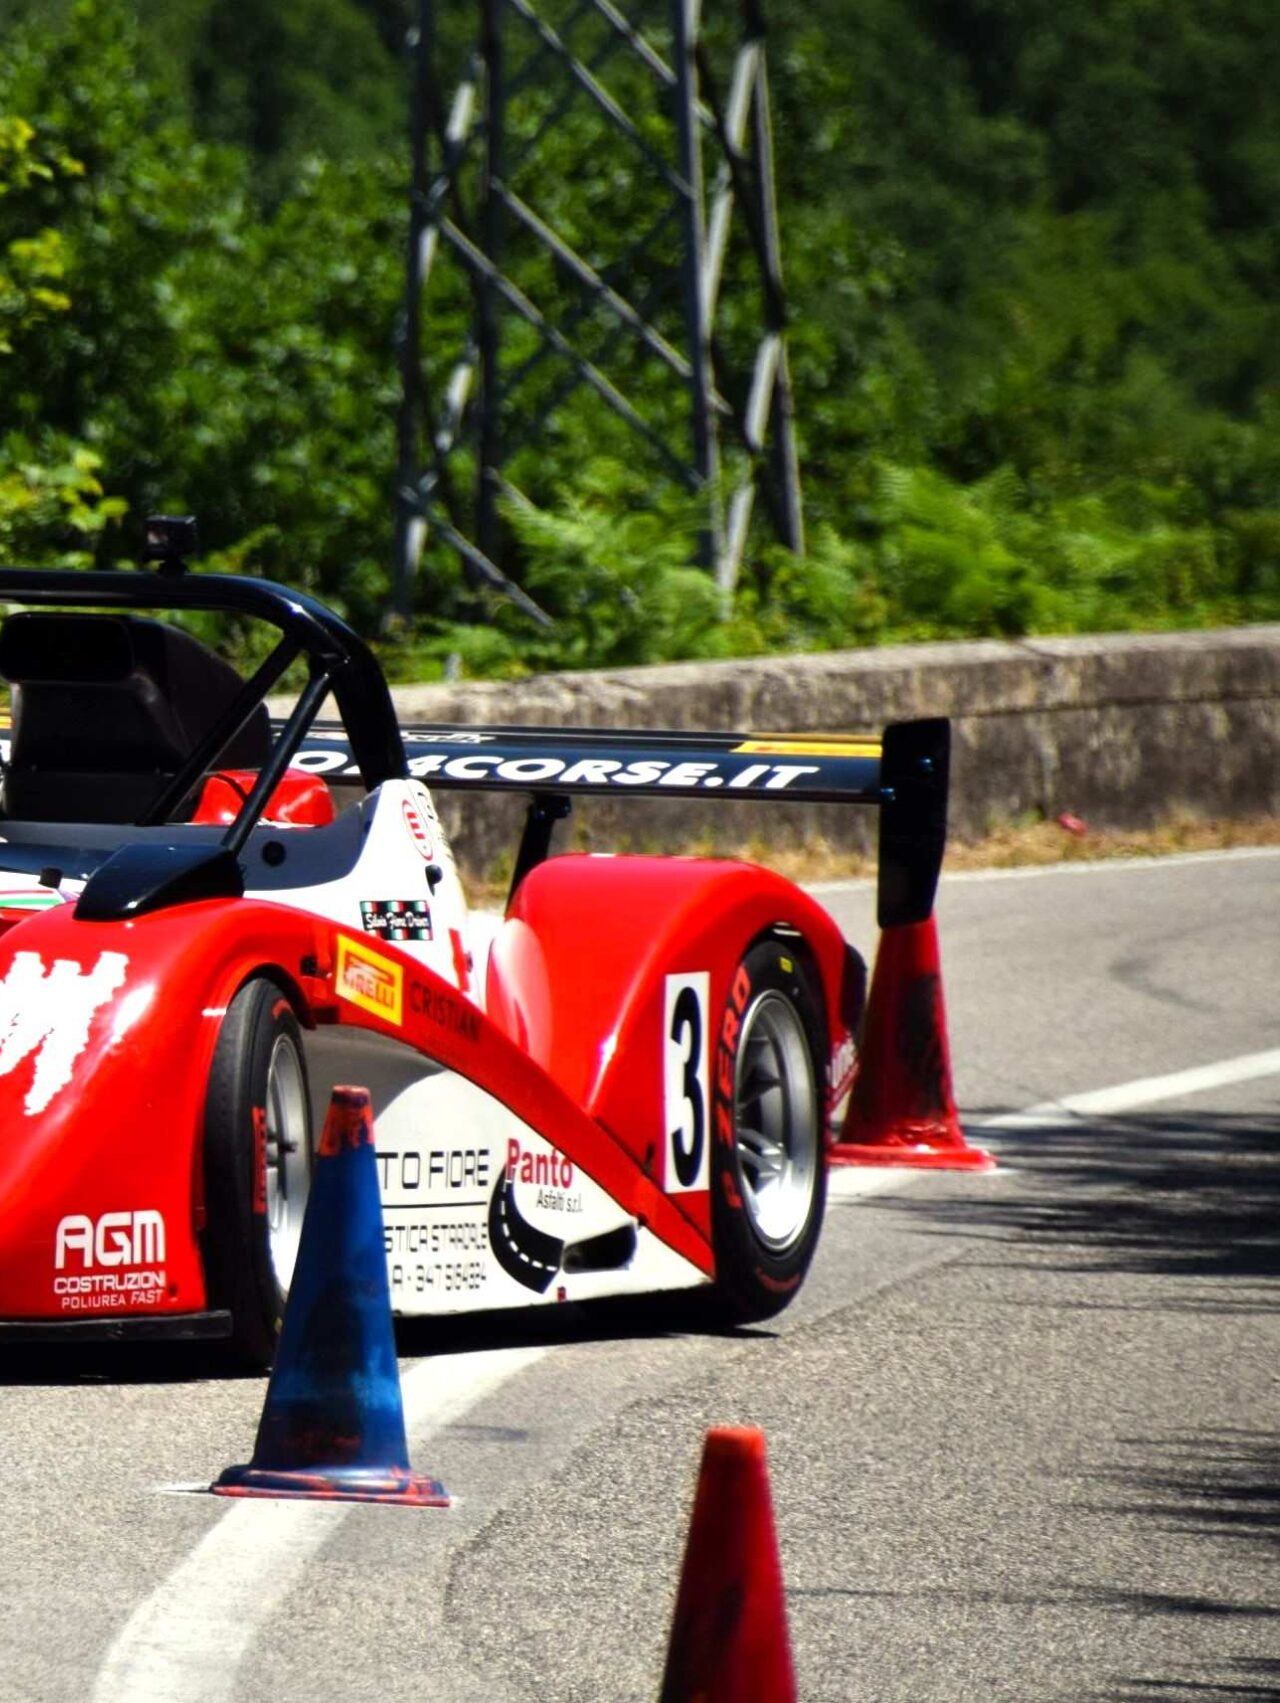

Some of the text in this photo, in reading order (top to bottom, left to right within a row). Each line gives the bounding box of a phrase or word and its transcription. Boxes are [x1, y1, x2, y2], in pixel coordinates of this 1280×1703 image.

[410, 980, 483, 1043] CRISTIAN
[670, 986, 705, 1188] 3
[506, 1138, 573, 1189] Panto
[54, 1209, 166, 1270] AGM
[61, 1289, 164, 1310] POLIUREA FAST
